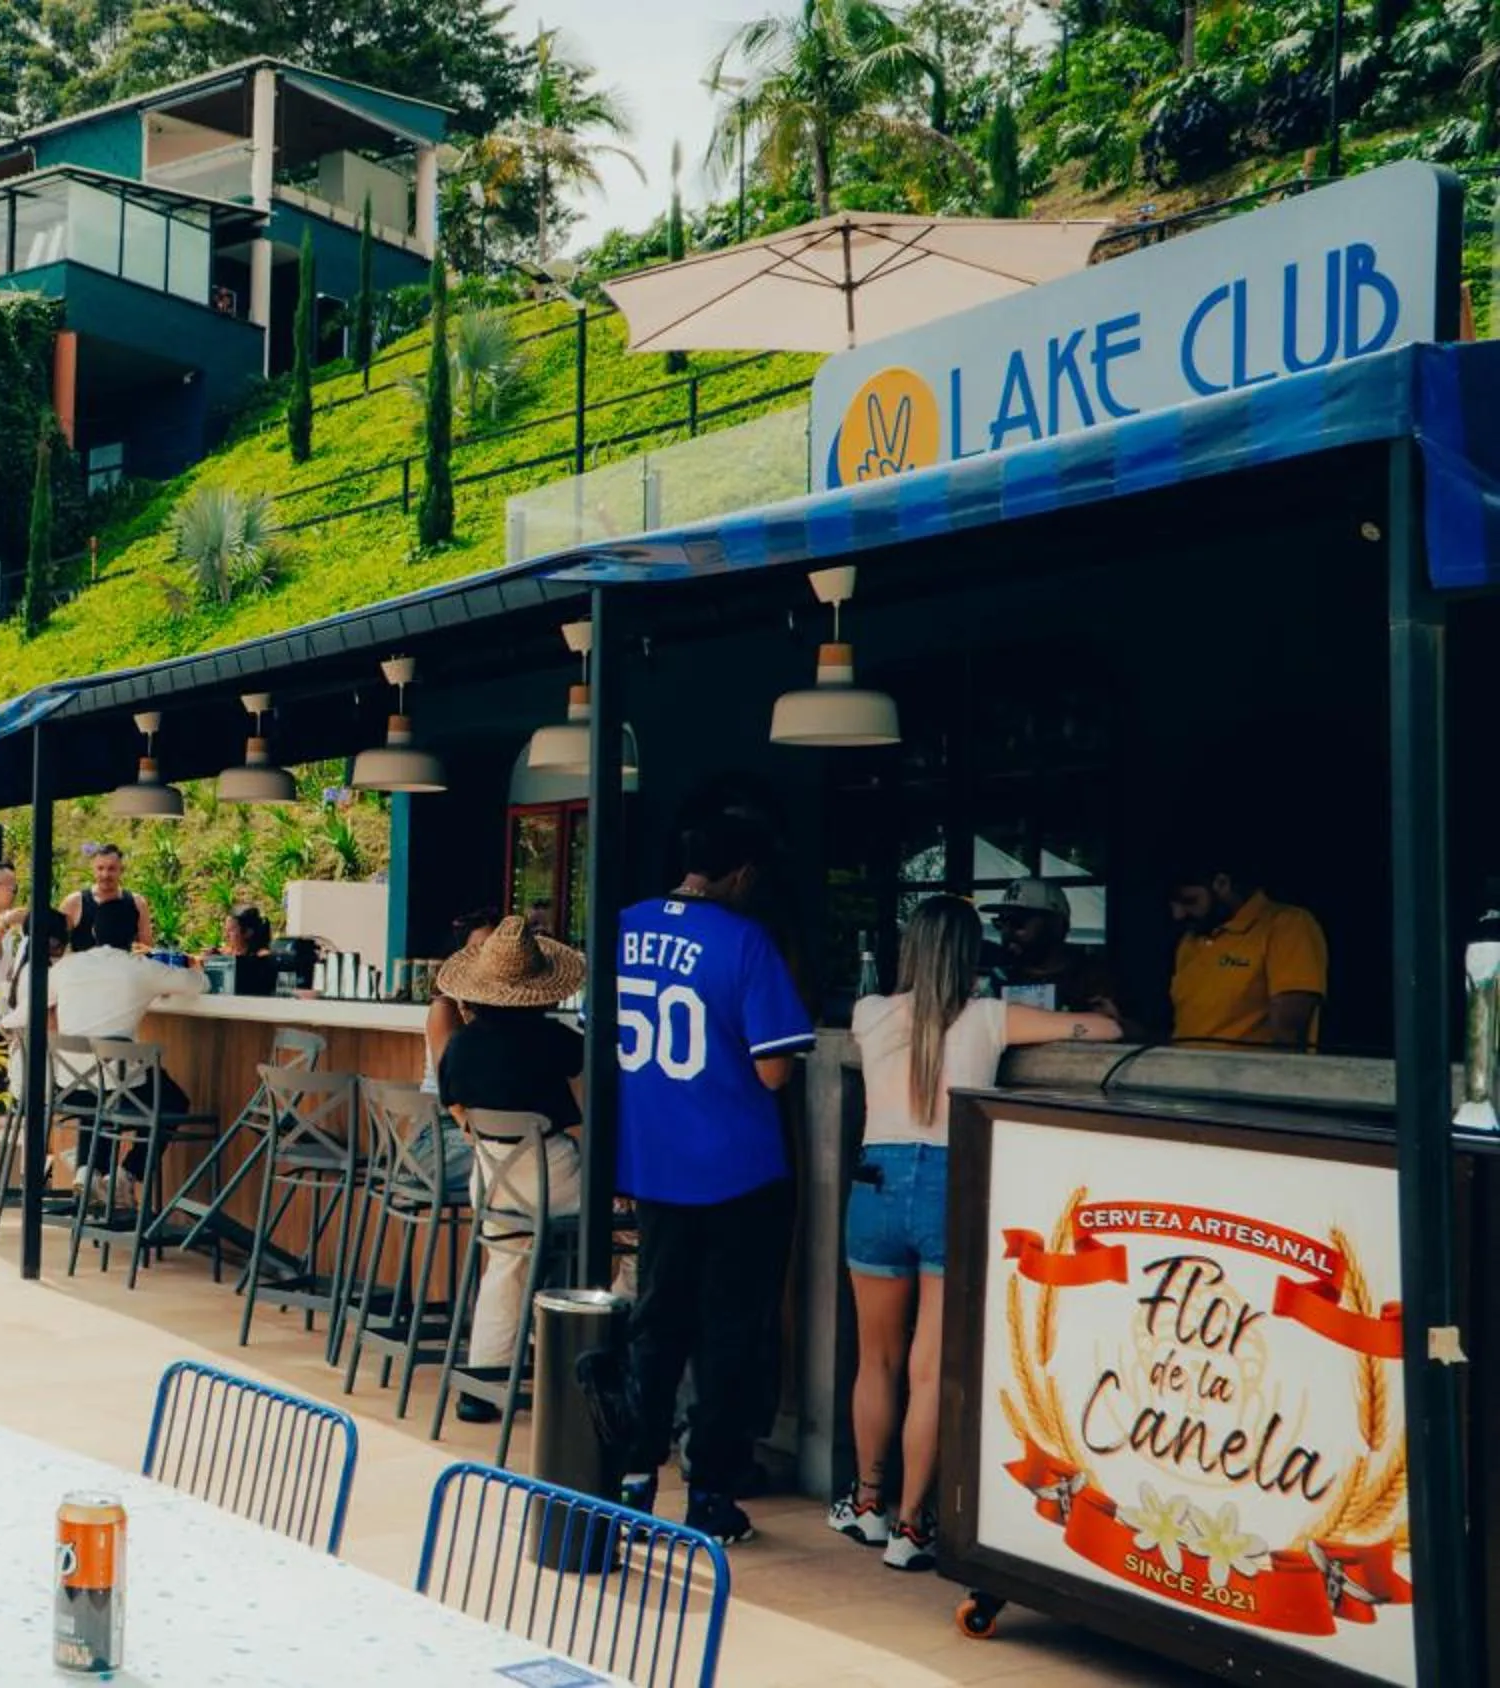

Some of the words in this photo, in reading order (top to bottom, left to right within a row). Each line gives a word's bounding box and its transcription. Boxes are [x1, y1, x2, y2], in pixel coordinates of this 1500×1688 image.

[951, 312, 1141, 460] LAKE
[1181, 243, 1400, 396] CLUB
[623, 931, 703, 976] BETTS
[616, 975, 706, 1081] 50
[1078, 1209, 1183, 1231] CERVEZA
[1187, 1215, 1334, 1275] ARTESANAL
[1137, 1255, 1267, 1355] Flor
[1149, 1348, 1184, 1397] de
[1197, 1360, 1233, 1403] la
[1081, 1369, 1337, 1502] Canela
[1123, 1553, 1196, 1595] SINCE
[1201, 1583, 1257, 1612] 2021
